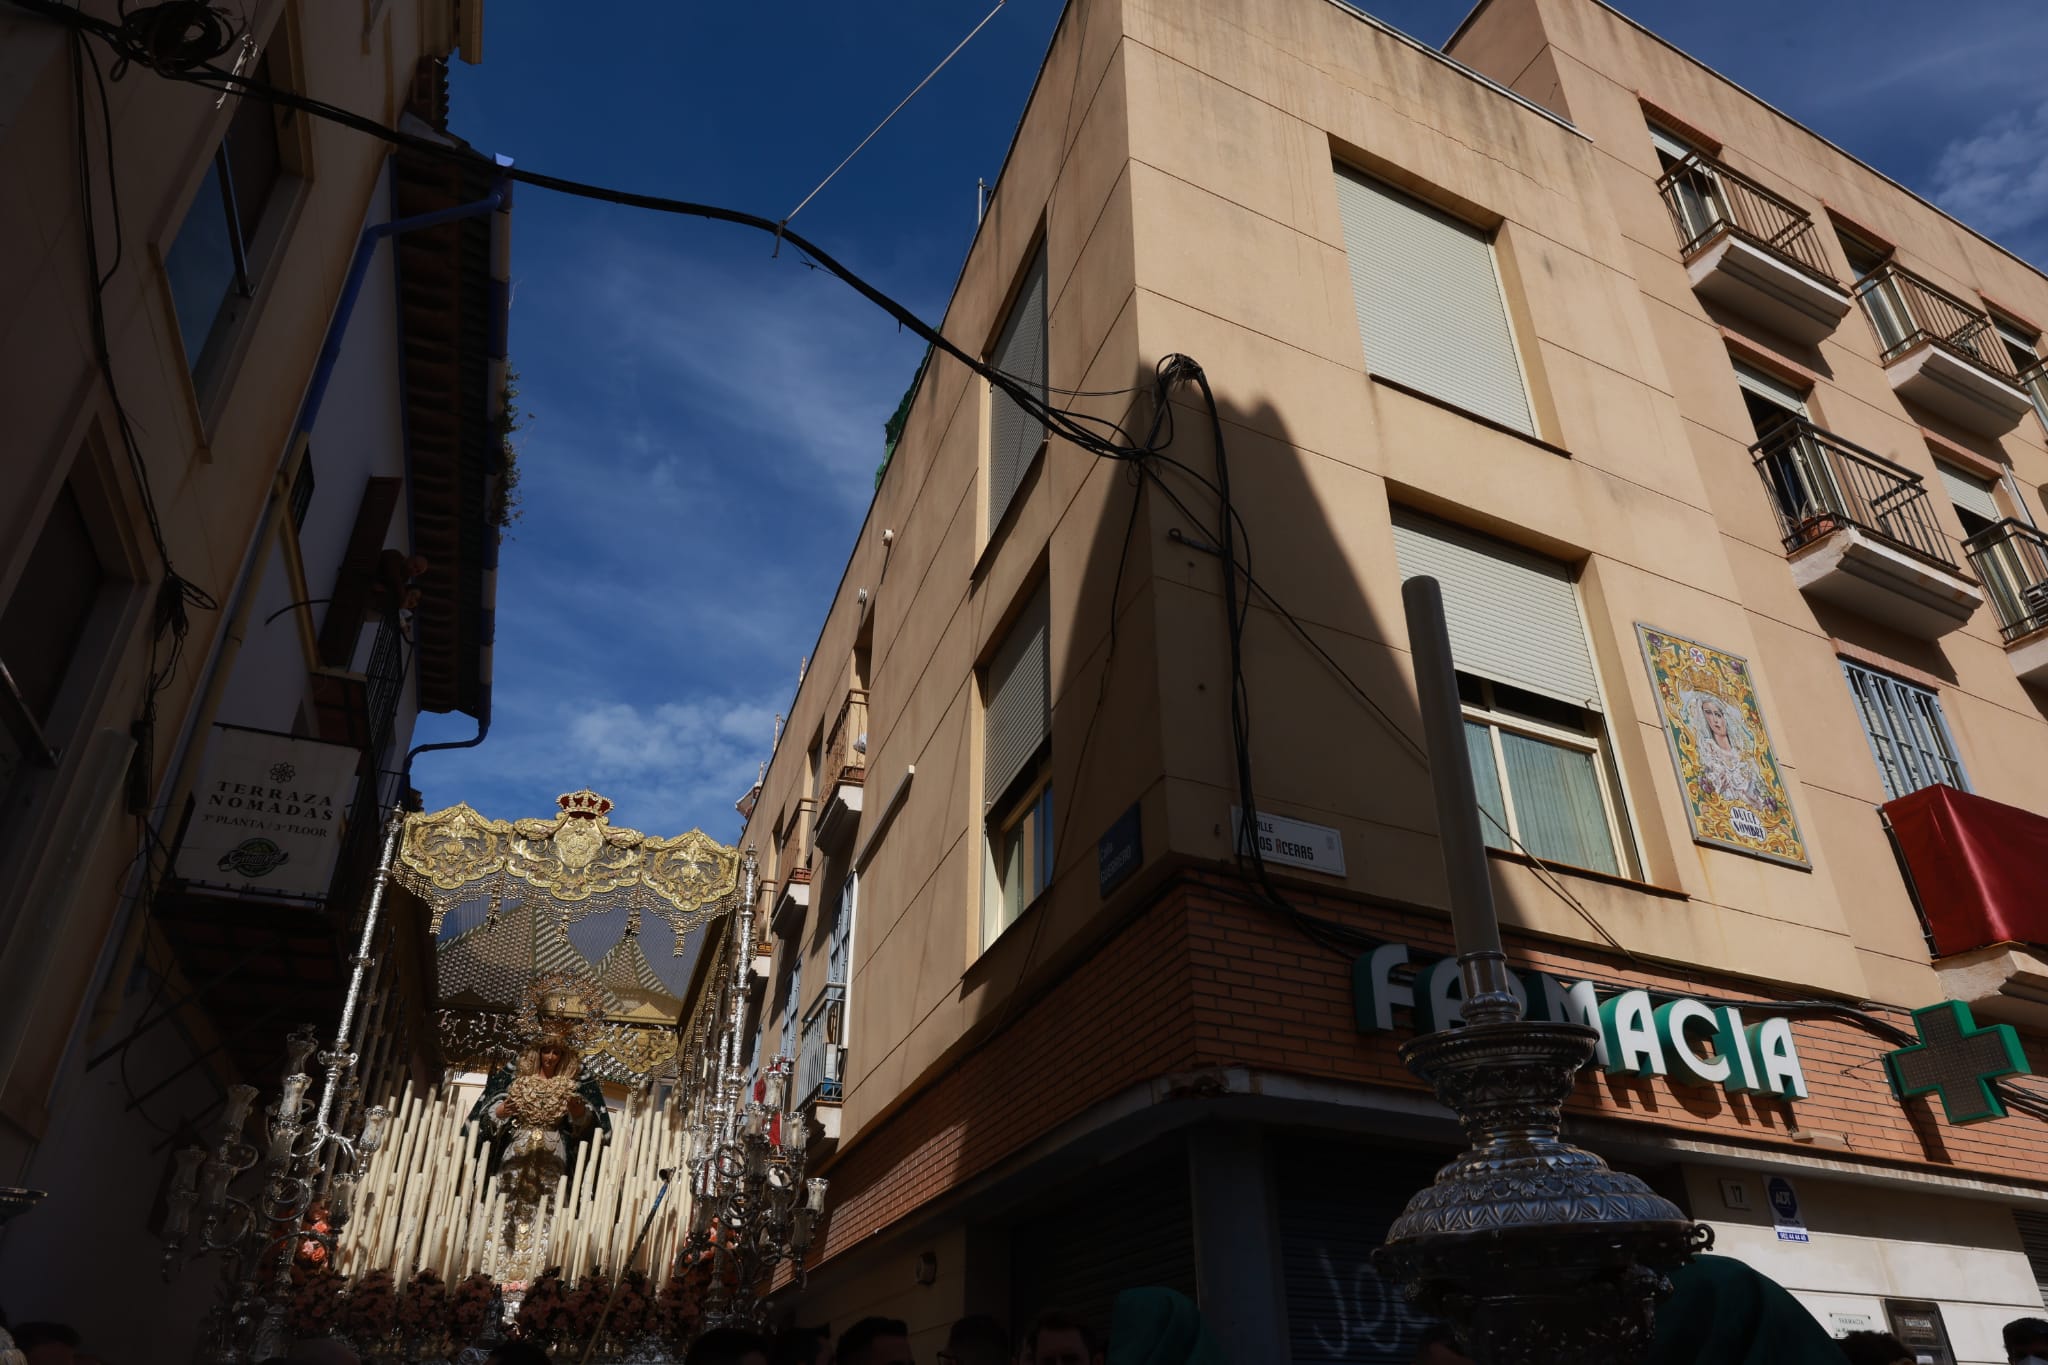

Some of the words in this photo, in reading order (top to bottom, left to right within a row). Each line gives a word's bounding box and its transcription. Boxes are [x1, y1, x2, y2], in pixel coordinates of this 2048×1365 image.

[216, 780, 332, 807] TERRAZA
[208, 794, 334, 821] NOMADAS
[1732, 807, 1757, 825] DULCE
[215, 815, 265, 830] PLANTA
[287, 824, 328, 838] FLOOR
[1255, 820, 1274, 834] ALLE
[1259, 836, 1274, 853] OS
[1275, 838, 1314, 862] ACERAS
[1775, 1191, 1792, 1206] ADT
